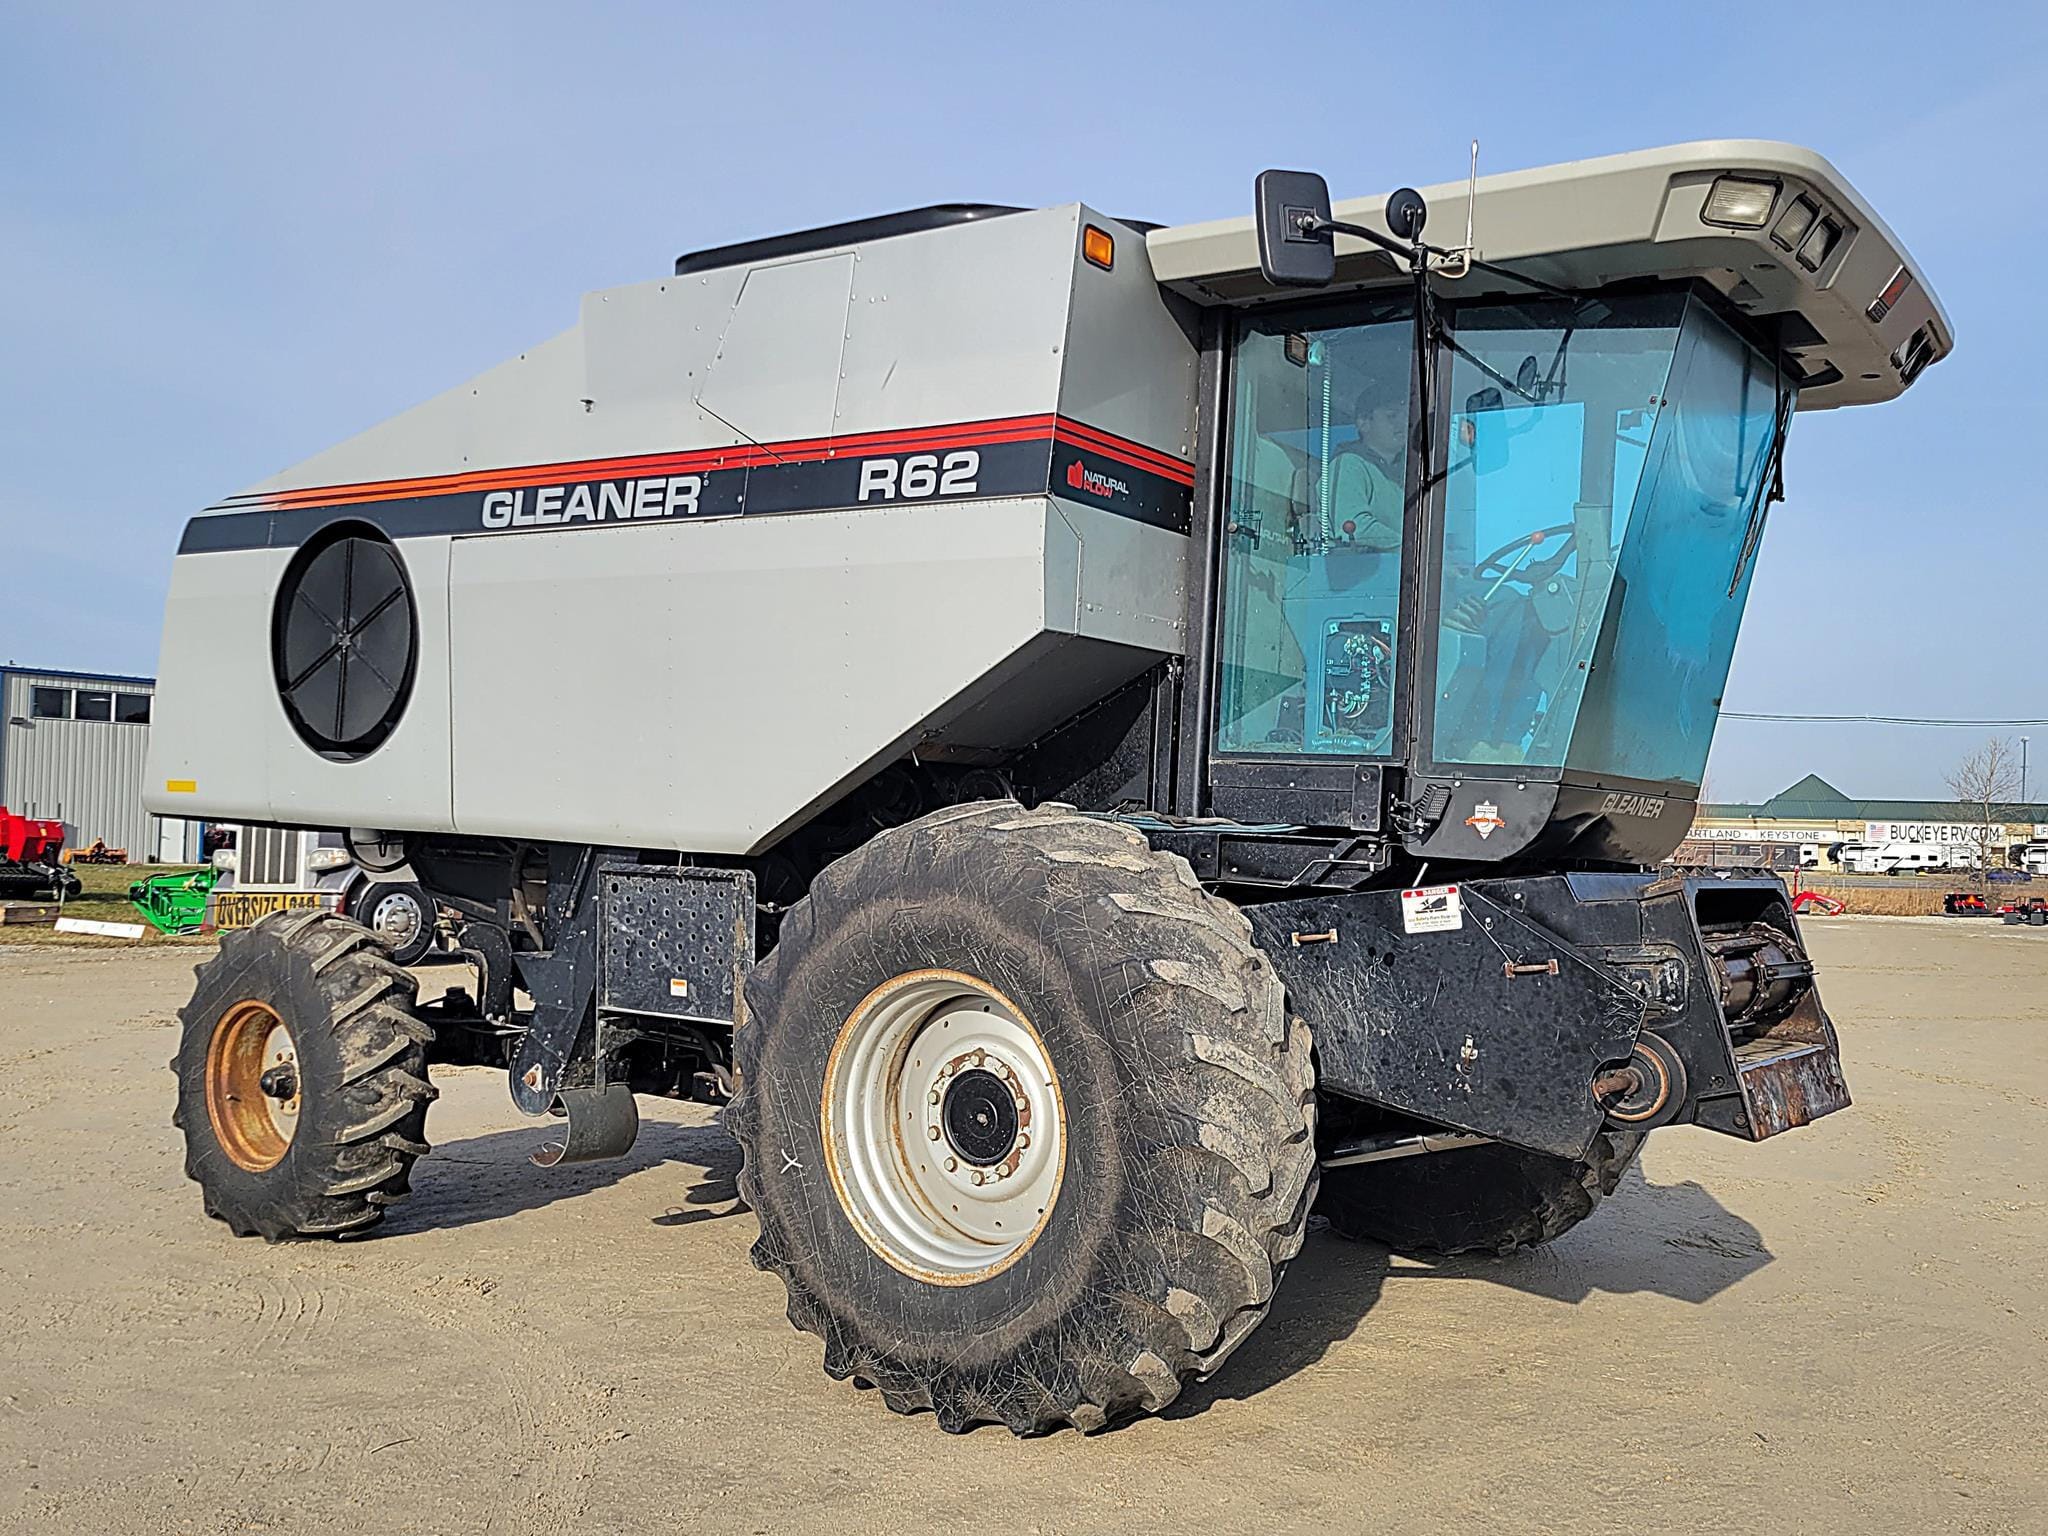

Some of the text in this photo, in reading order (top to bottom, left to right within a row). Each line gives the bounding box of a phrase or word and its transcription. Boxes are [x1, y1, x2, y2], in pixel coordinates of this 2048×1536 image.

[858, 450, 980, 501] R62
[1084, 469, 1129, 494] NATURAL
[1083, 480, 1113, 498] FLOW
[482, 476, 702, 529] GLEANER
[1600, 793, 1665, 819] GLEANER
[1688, 829, 1820, 839] ARTLAND KEYSTONE
[2036, 826, 2048, 836] LIF
[219, 895, 279, 926] OVERSIZE
